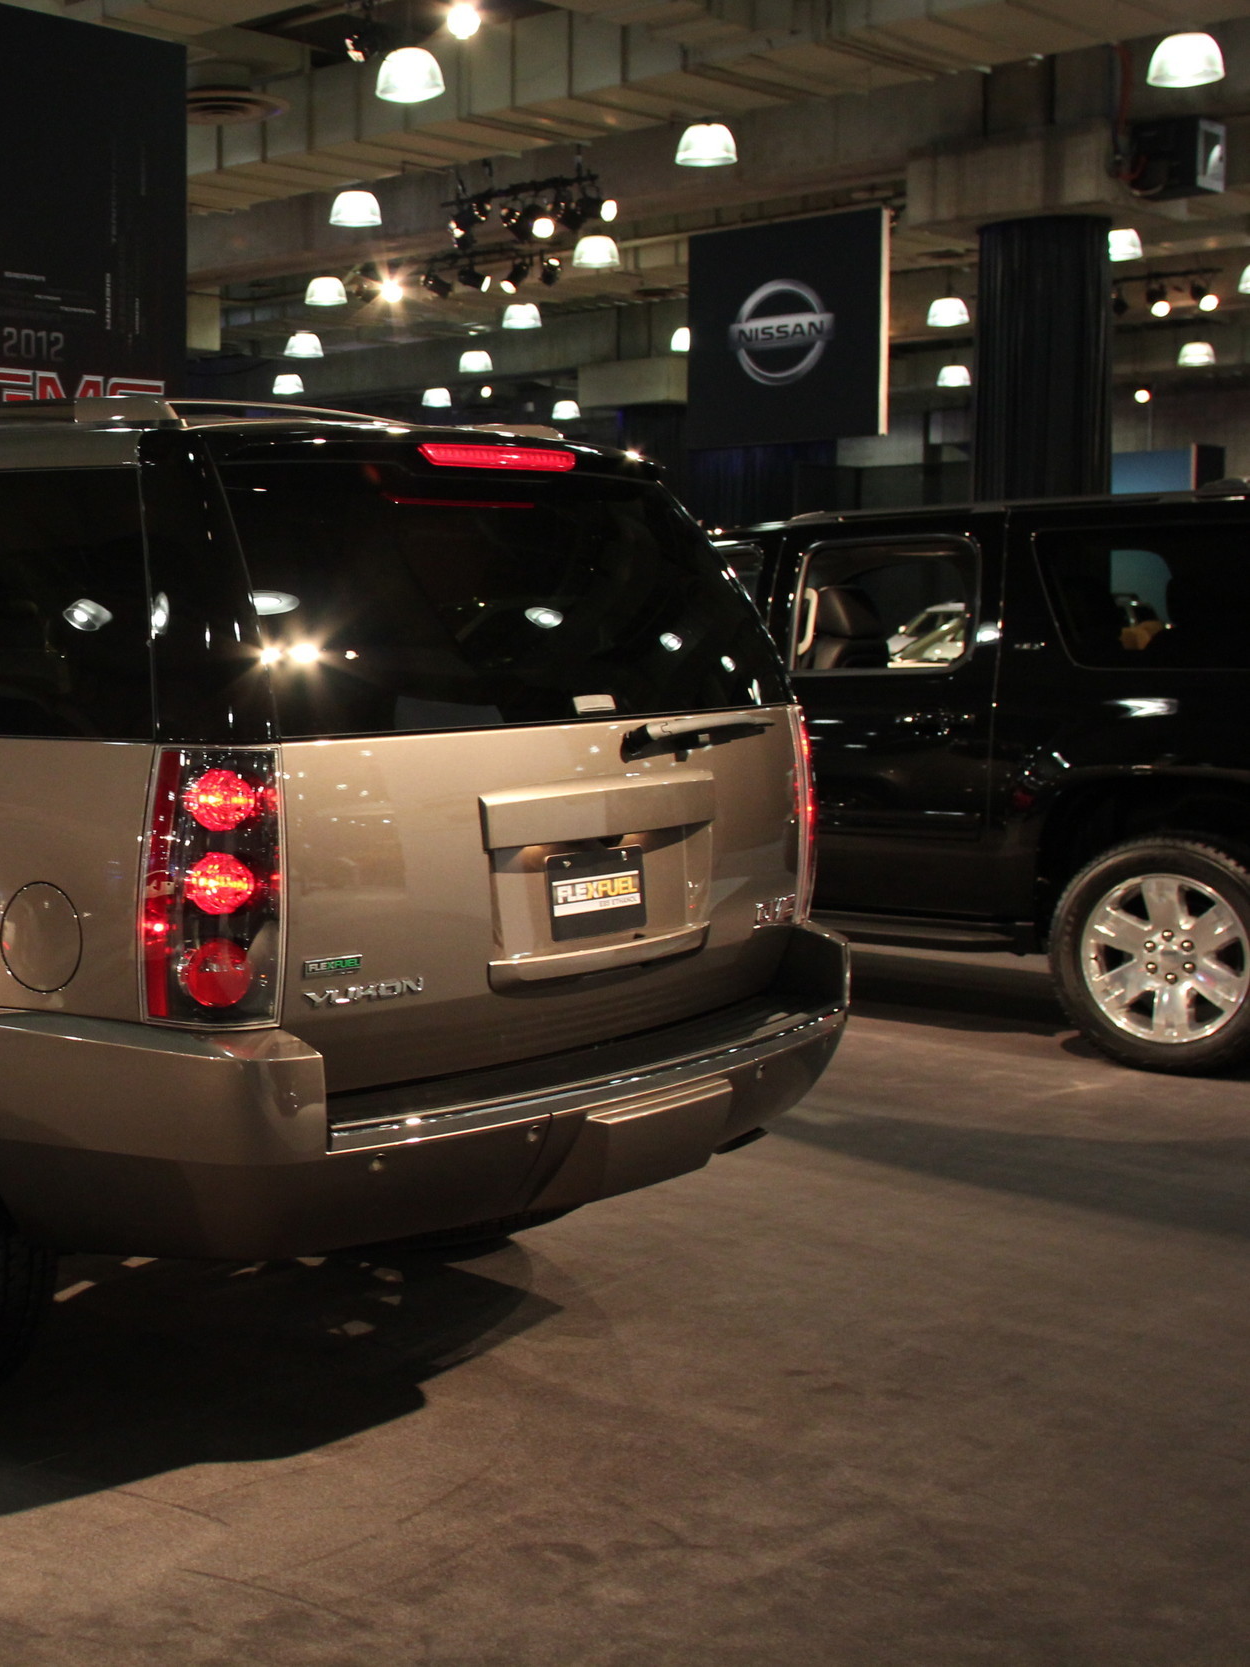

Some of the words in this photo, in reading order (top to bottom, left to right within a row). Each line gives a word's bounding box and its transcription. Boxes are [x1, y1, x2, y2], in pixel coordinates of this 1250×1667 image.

[2, 327, 65, 362] 2012
[738, 320, 825, 342] NISSAN
[556, 876, 638, 904] FLEXFUEL
[308, 958, 361, 972] FLEXFUEL
[304, 977, 424, 1007] YUKON
